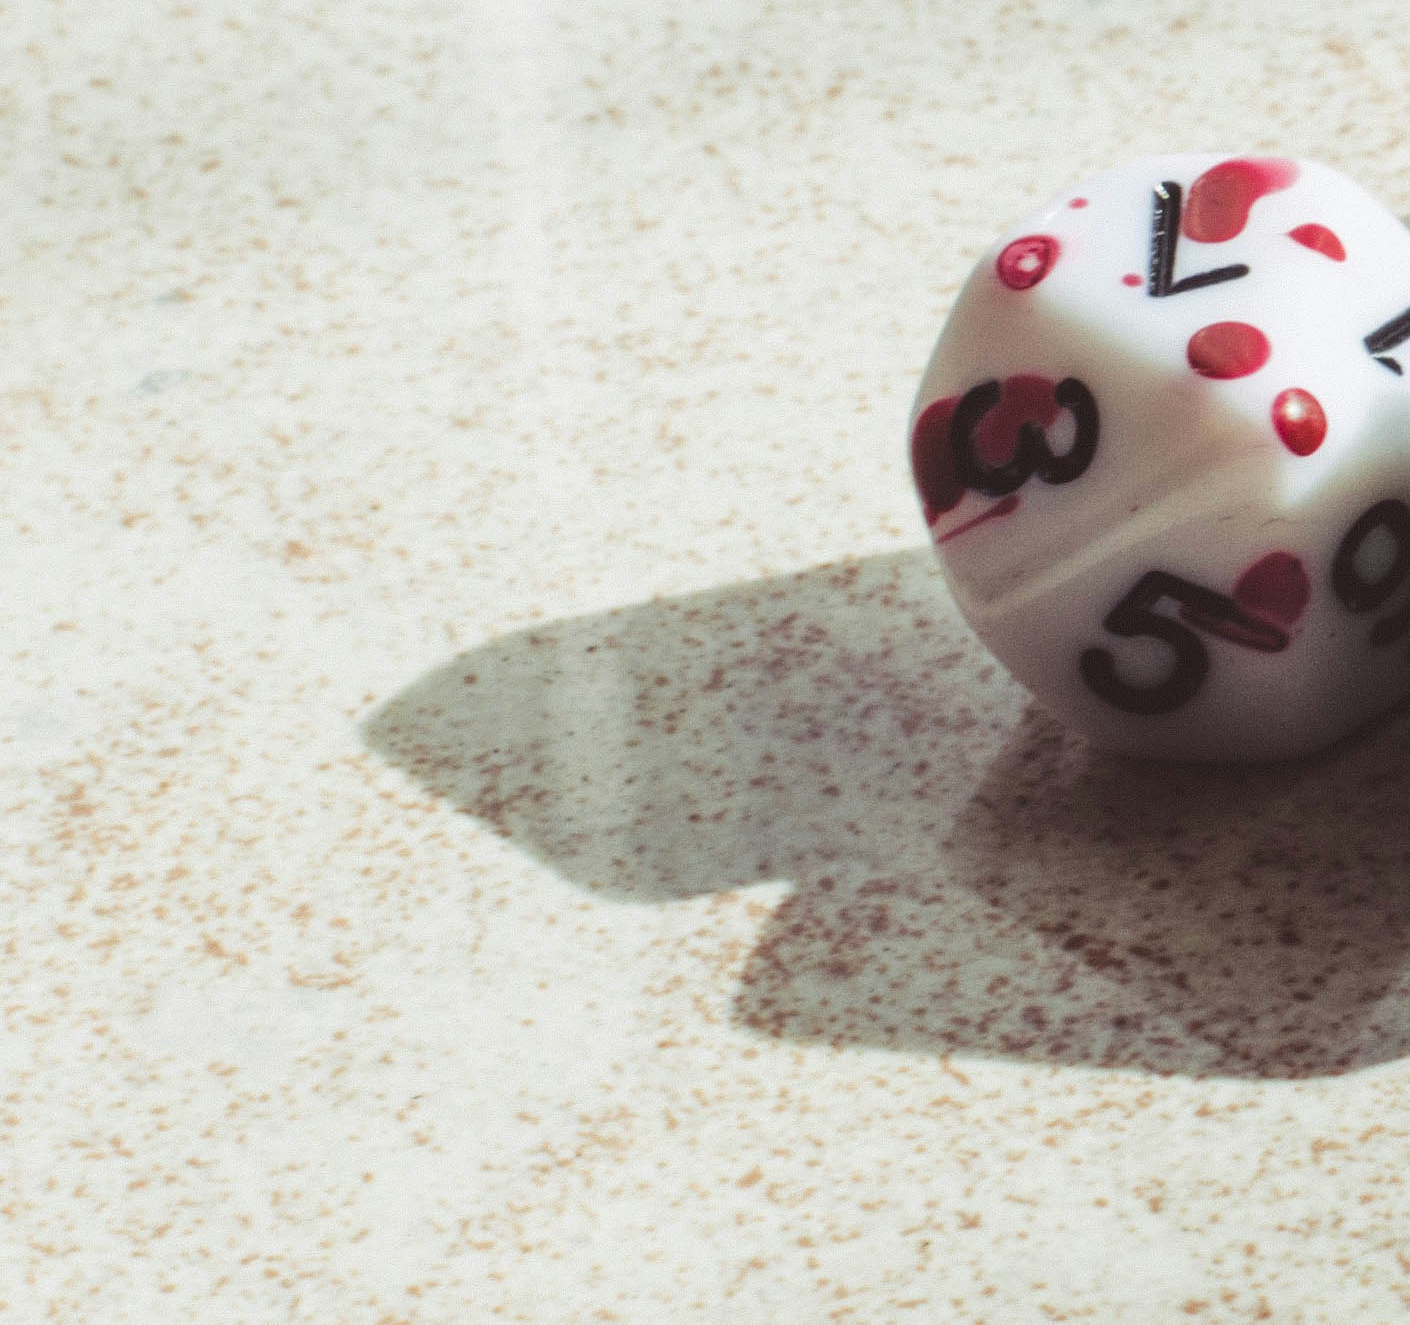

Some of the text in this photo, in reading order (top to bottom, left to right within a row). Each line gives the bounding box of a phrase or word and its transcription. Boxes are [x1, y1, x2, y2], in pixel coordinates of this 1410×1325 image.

[1149, 180, 1249, 297] 7
[948, 377, 1098, 497] 3
[1079, 570, 1290, 716] 5
